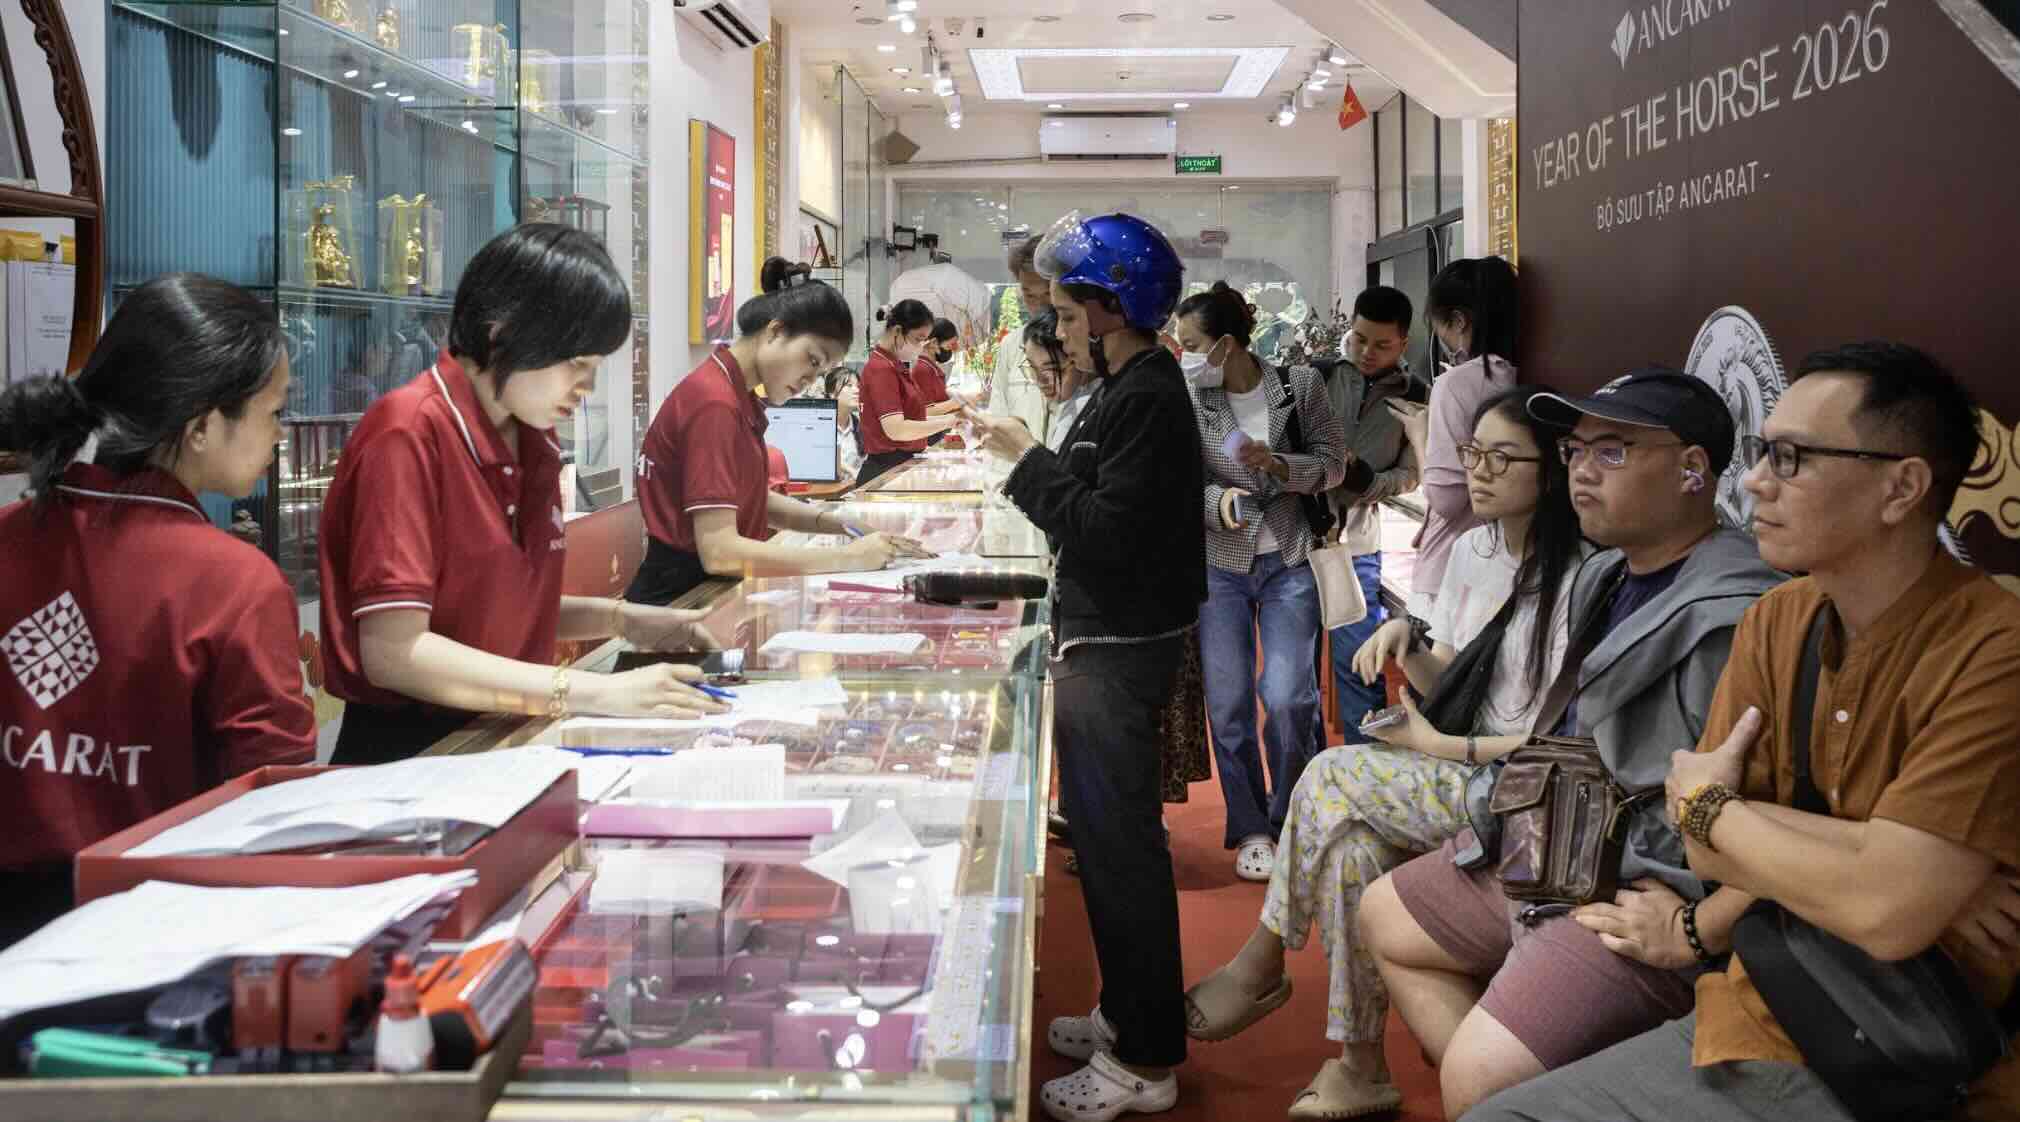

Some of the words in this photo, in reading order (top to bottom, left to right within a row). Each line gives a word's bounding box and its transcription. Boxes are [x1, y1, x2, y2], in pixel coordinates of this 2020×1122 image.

[1637, 0, 1732, 54] ANCA
[1533, 131, 1580, 191] YEAR
[1585, 116, 1615, 172] OF
[1620, 93, 1667, 160] THE
[1676, 45, 1780, 141] HORSE
[1792, 0, 1889, 100] 2026
[1597, 196, 1613, 232] BỘ
[1646, 181, 1674, 221] TẬP
[1680, 161, 1760, 209] ANCARAT
[0, 723, 152, 787] CARAT
